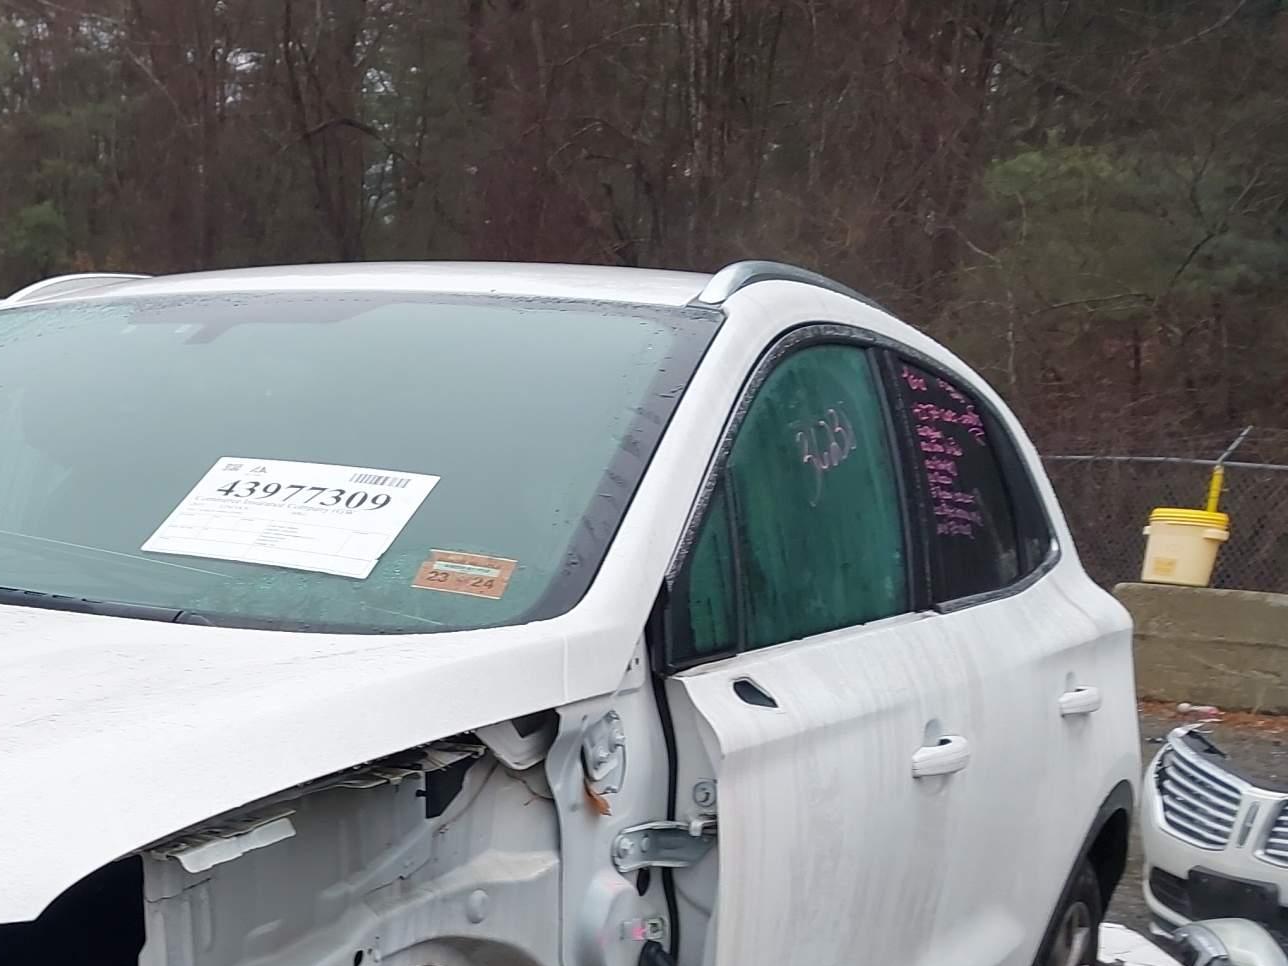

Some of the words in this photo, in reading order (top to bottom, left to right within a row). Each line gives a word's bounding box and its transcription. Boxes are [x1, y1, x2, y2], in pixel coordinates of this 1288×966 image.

[216, 479, 393, 513] 43977309
[425, 570, 450, 583] 23
[470, 576, 495, 589] 24
